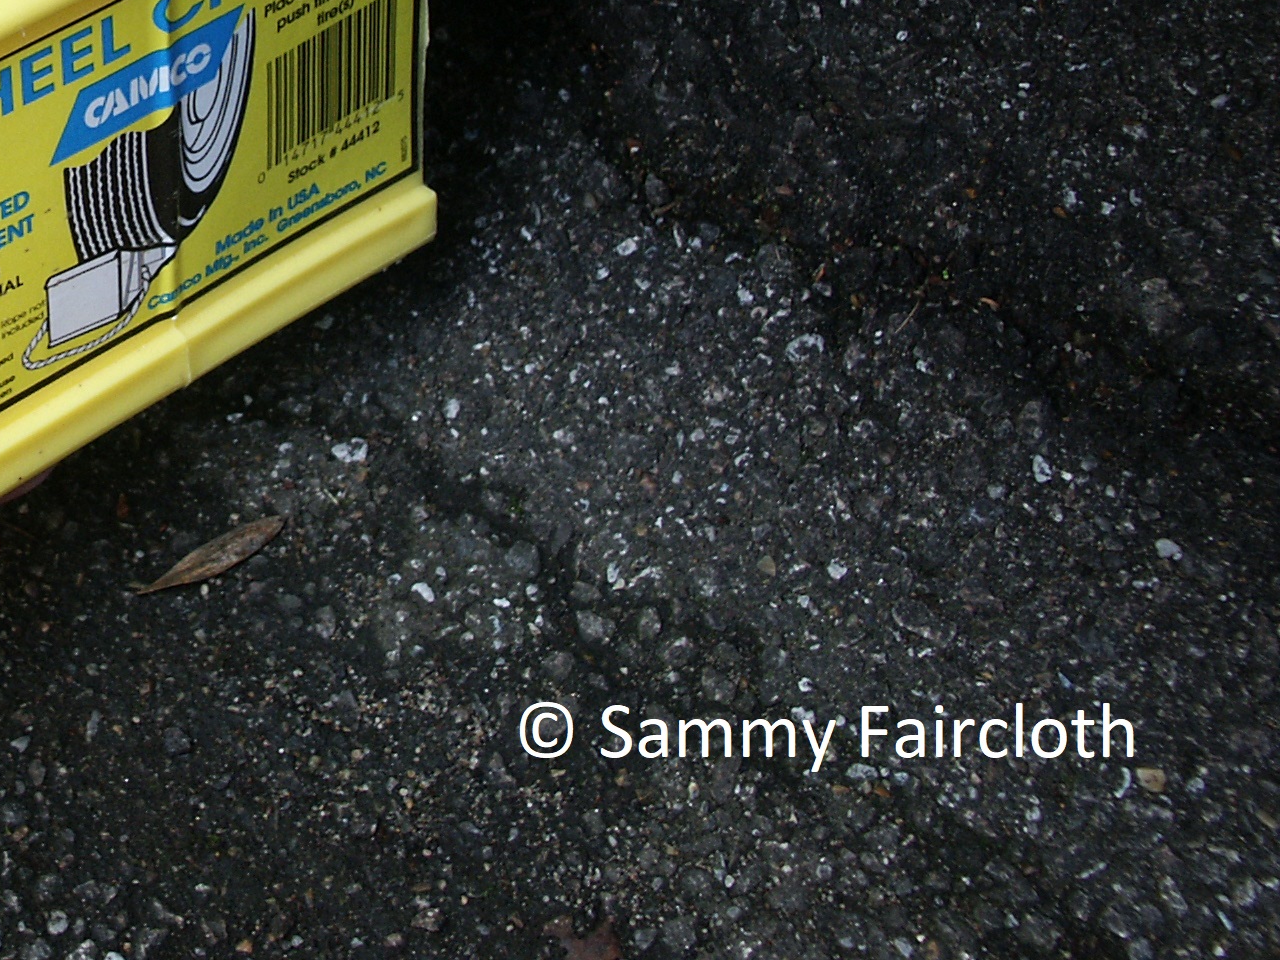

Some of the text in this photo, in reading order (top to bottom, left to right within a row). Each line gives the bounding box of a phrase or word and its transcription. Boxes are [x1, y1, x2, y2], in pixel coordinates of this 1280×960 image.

[276, 1, 310, 33] push
[83, 43, 212, 129] CAMCO
[287, 154, 326, 184] Stock
[329, 145, 338, 159] #
[340, 120, 381, 153] 44412
[147, 273, 203, 311] Camco
[365, 161, 388, 184] NC
[215, 217, 266, 256] Made
[287, 182, 320, 210] USA
